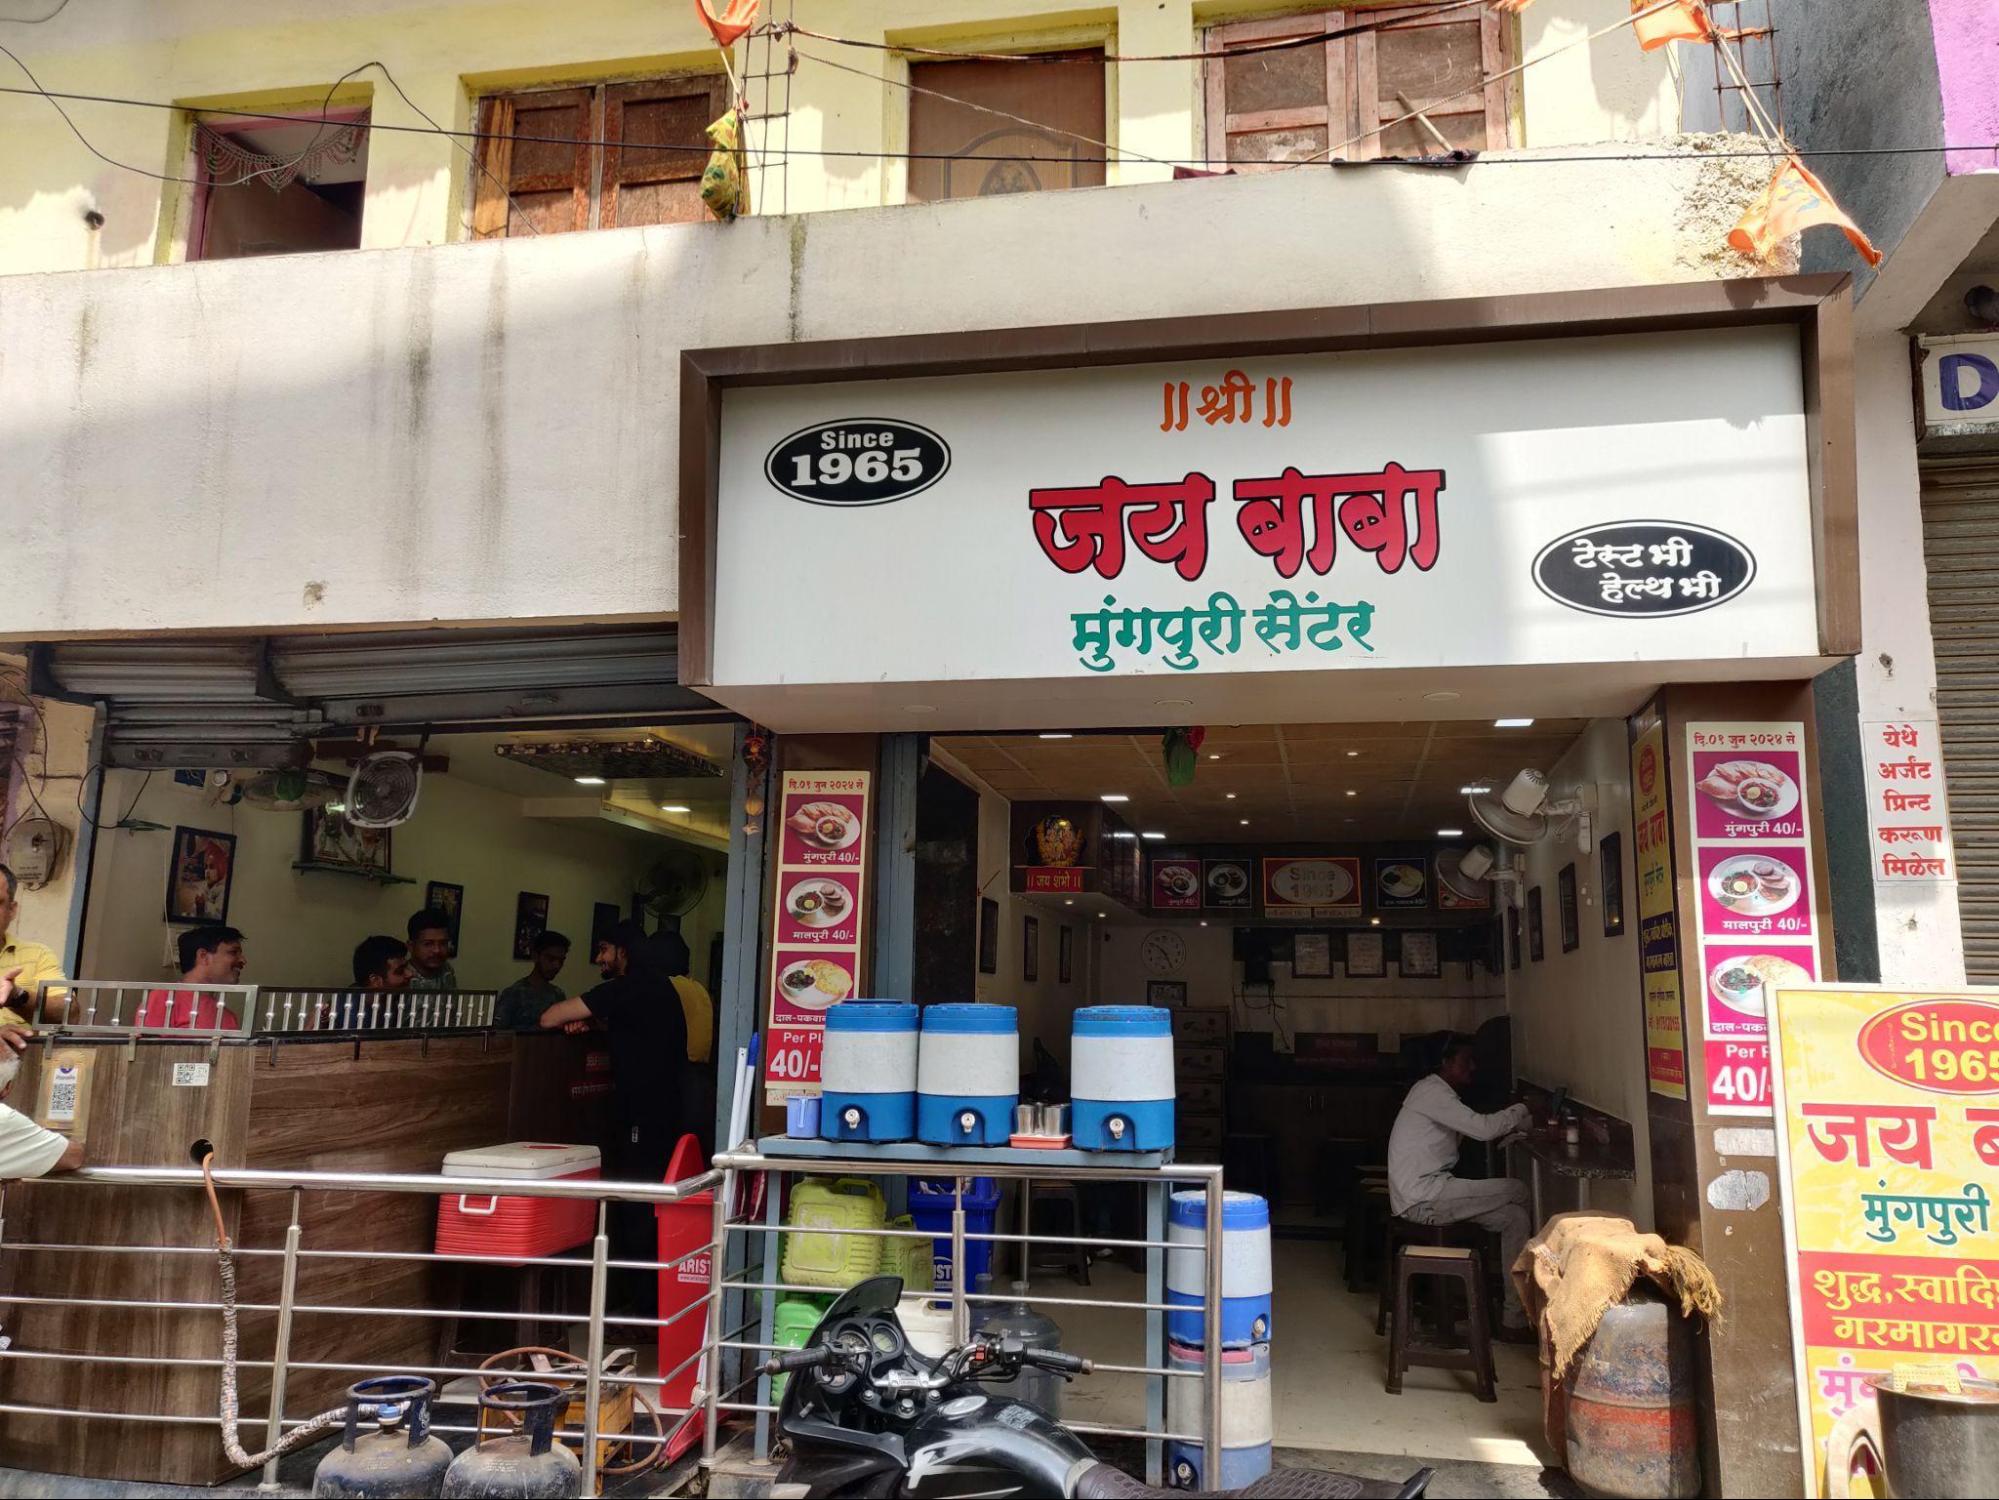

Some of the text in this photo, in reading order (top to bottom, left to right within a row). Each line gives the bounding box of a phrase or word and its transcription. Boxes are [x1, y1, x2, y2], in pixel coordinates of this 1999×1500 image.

[820, 430, 894, 450] Since
[791, 447, 923, 486] 1965
[1028, 461, 1446, 582] जय बाबा
[1572, 536, 1693, 568] टेस्ट भी
[1599, 570, 1722, 603] हेल्थ भी
[1070, 591, 1246, 672] मुंगपुरी
[1750, 734, 1783, 746] २०२४
[1786, 731, 1796, 745] से
[1883, 724, 1918, 748] येथे
[1878, 755, 1932, 780] अर्जंट
[1883, 789, 1931, 811] प्रिन्ट
[1724, 821, 1803, 837] मुंगपुरी 40/-
[803, 851, 860, 864] मुंगपुरी 40/-
[1882, 852, 1945, 876] मिळेल
[792, 927, 854, 942] मालपुरी 40/-
[1722, 917, 1807, 933] मालपुरी 40/-
[783, 1032, 805, 1044] Per
[1726, 1044, 1756, 1058] Per
[770, 1049, 818, 1078] 40/-
[1802, 1103, 1936, 1170] जय
[1861, 1179, 1990, 1246] मुंगपुरी
[1814, 1265, 1999, 1311] शुद्ध,स्वादि
